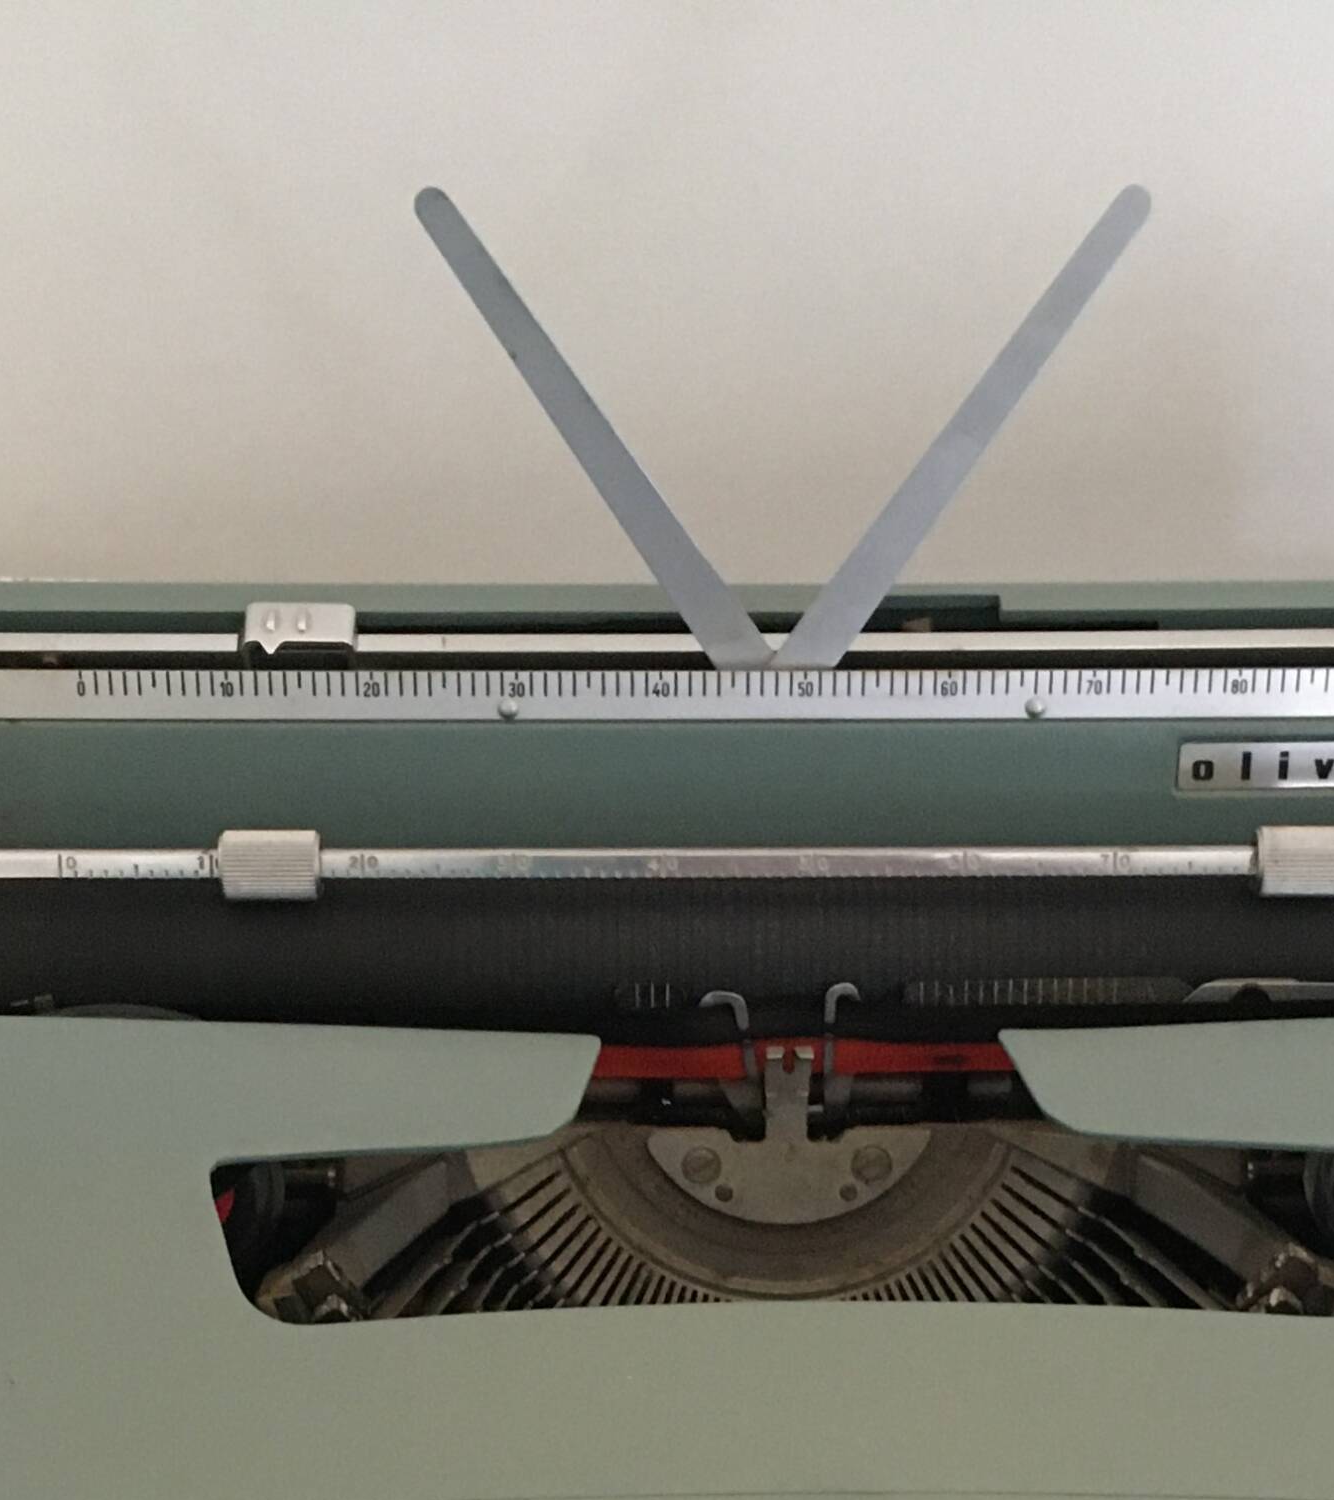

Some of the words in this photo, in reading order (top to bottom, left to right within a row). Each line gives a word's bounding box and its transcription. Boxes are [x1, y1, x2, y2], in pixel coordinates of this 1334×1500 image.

[76, 680, 86, 697] 0
[220, 681, 234, 697] 10
[363, 682, 380, 698] 20
[509, 682, 525, 698] 30
[652, 684, 670, 697] 40
[797, 681, 814, 697] 50
[940, 681, 958, 696] 60
[1086, 679, 1103, 695] 70
[1231, 679, 1248, 694] 80
